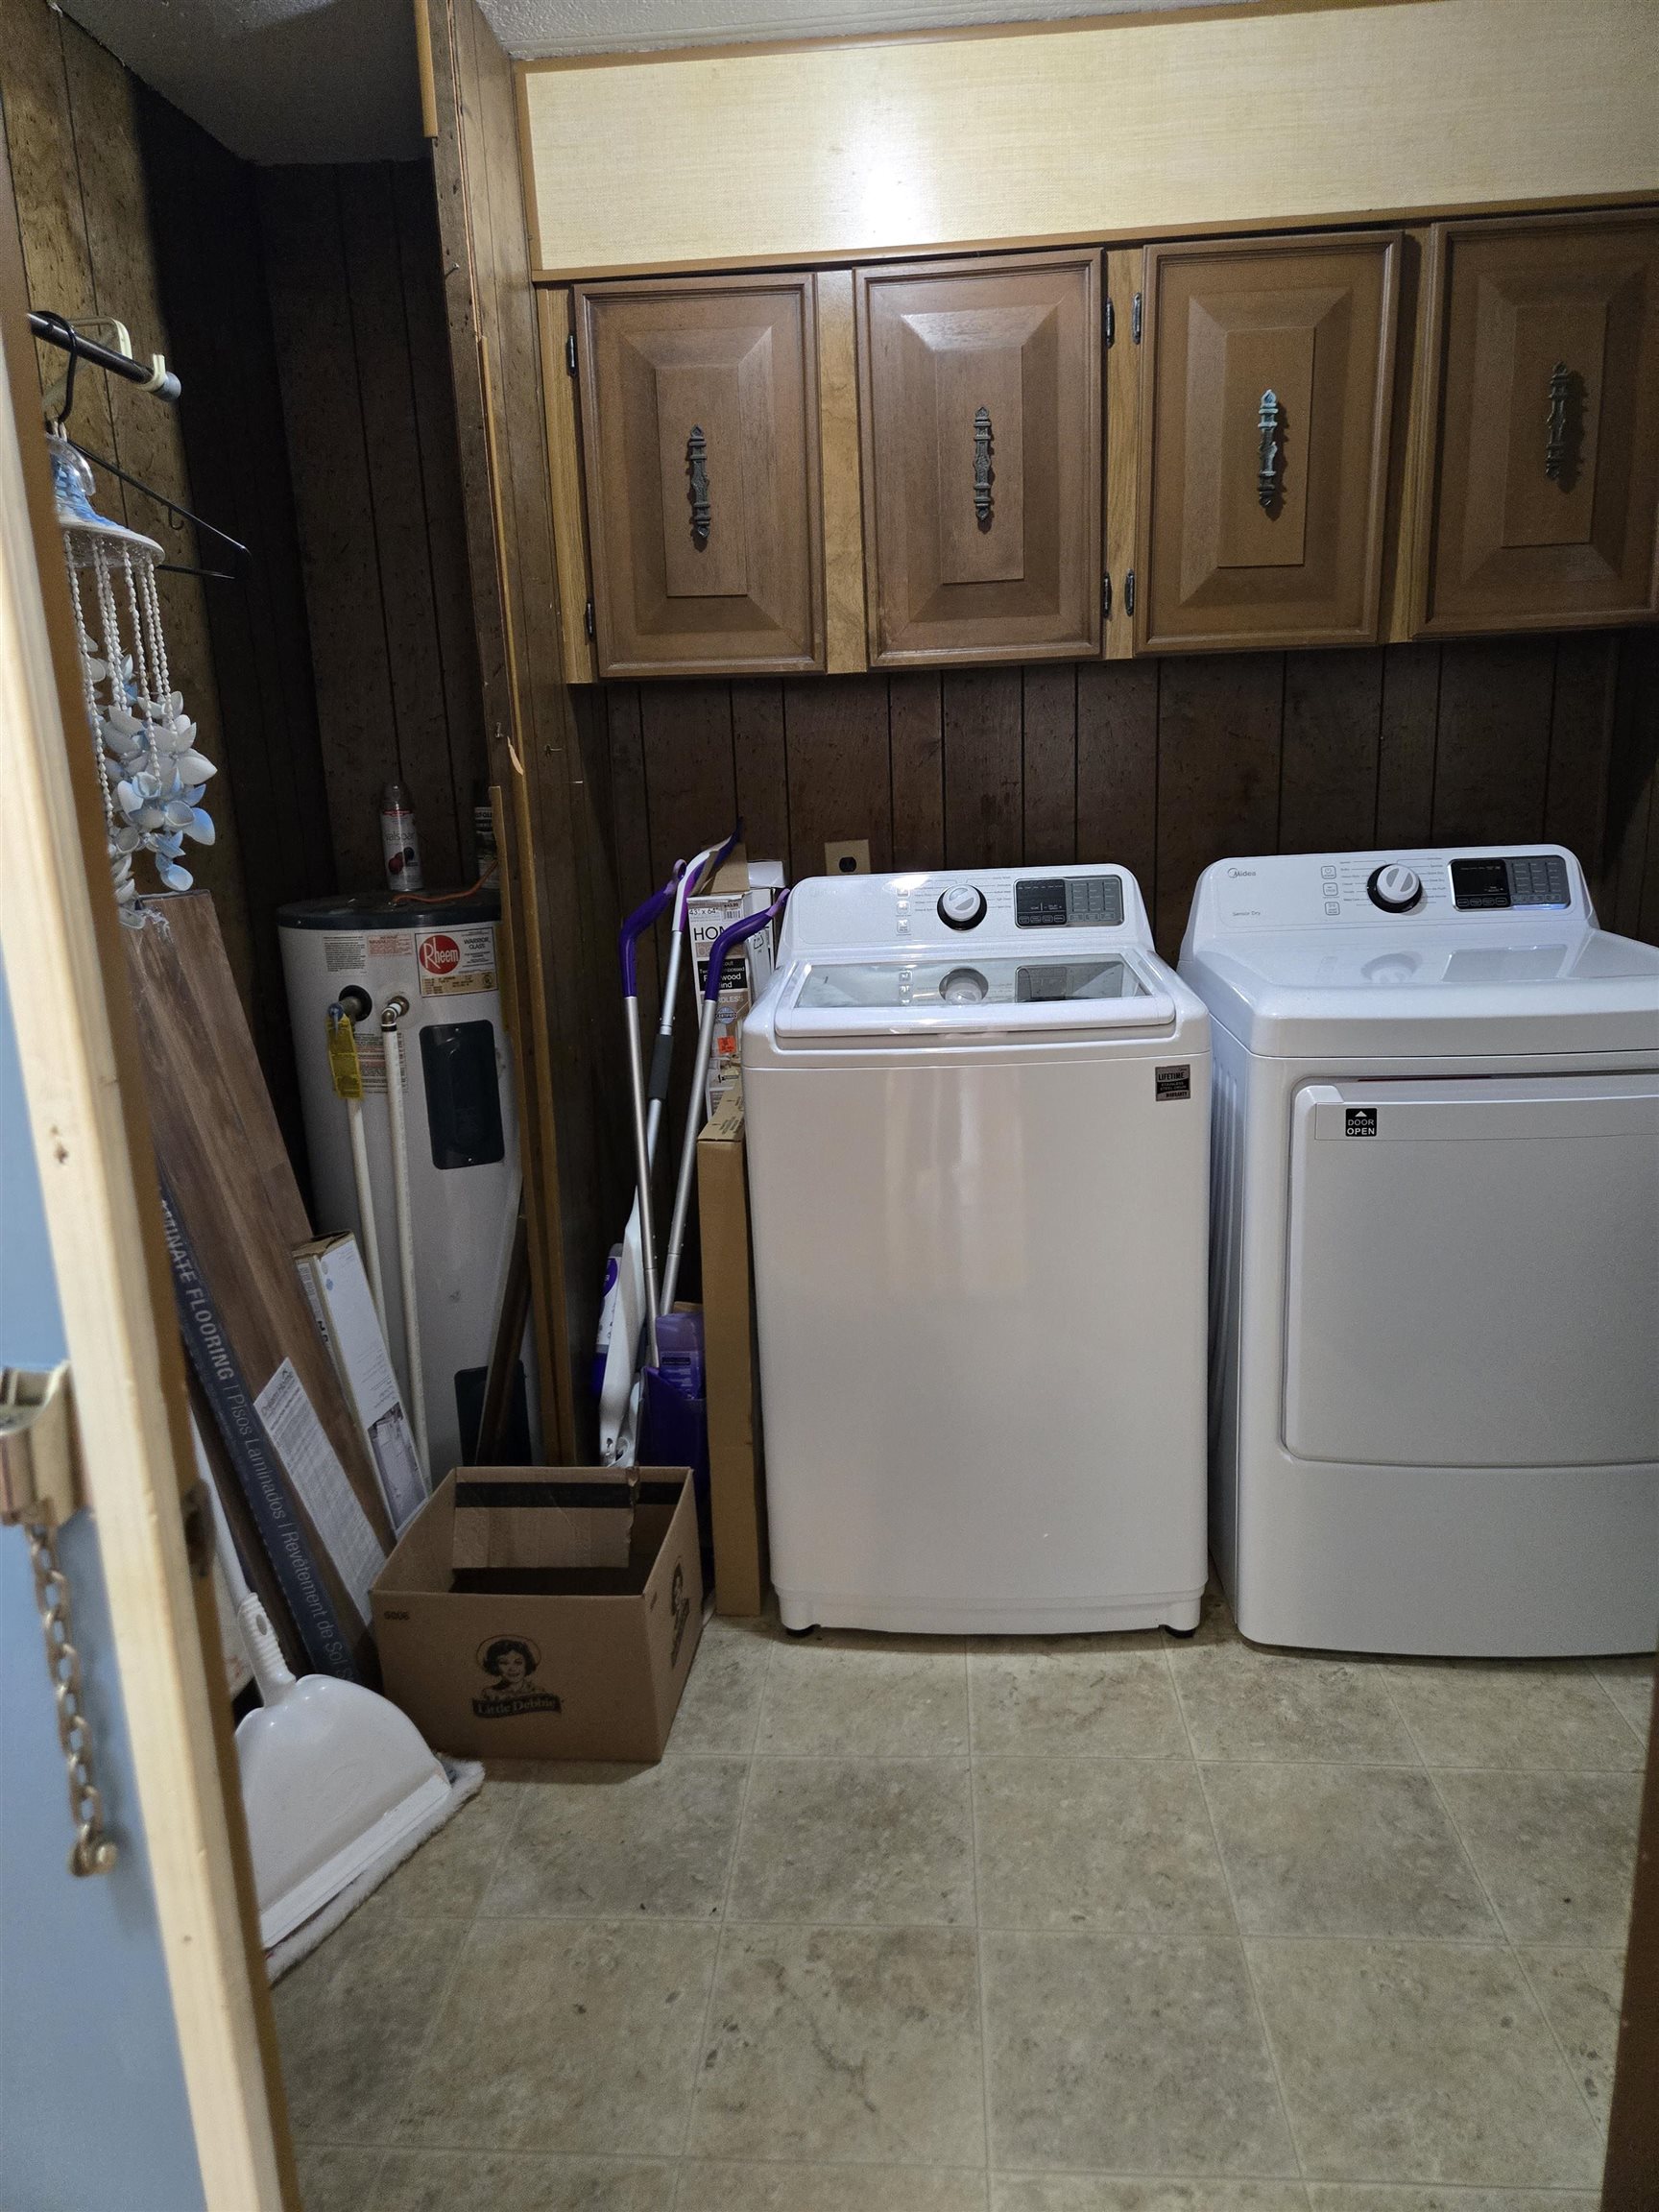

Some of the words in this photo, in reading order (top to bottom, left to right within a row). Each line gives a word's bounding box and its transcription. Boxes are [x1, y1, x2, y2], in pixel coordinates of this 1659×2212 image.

[1227, 867, 1256, 878] Midea
[423, 936, 459, 970] Rheem
[1159, 1071, 1184, 1081] LIFETIME
[1347, 1127, 1375, 1136] OPEN
[186, 1287, 235, 1381] FLOORING
[228, 1393, 252, 1436] Pisos
[245, 1437, 286, 1520] Laminados
[281, 1530, 328, 1618] Revêtement
[317, 1620, 334, 1639] de
[325, 1642, 348, 1665] Sol
[476, 1703, 511, 1715] Little
[512, 1697, 556, 1712] Debbie
